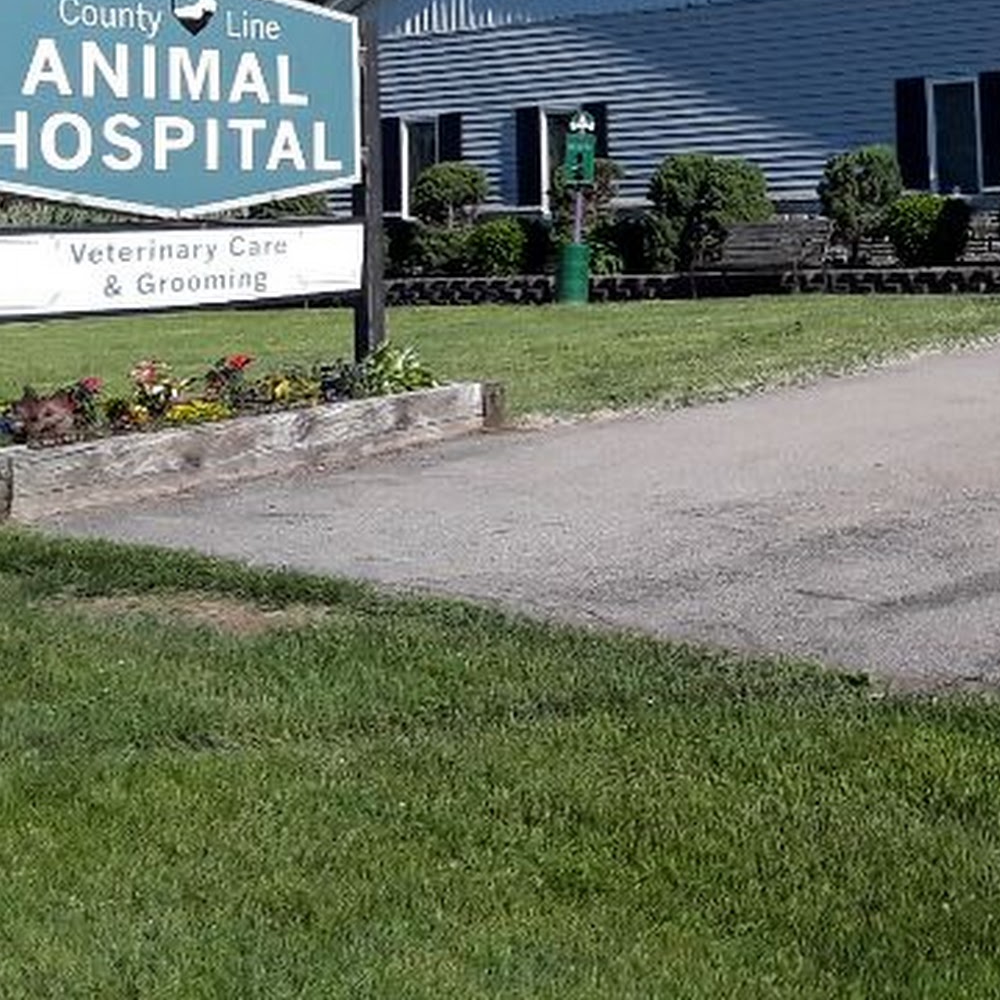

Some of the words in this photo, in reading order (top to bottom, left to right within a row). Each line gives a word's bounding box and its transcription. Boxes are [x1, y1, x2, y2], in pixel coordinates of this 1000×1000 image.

[226, 11, 281, 40] Line
[21, 38, 309, 106] ANIMAL
[0, 110, 343, 171] HOSPITAL
[70, 239, 217, 265] Veterinary
[229, 235, 288, 256] Care
[103, 275, 122, 297] &
[137, 270, 268, 296] Grooming
